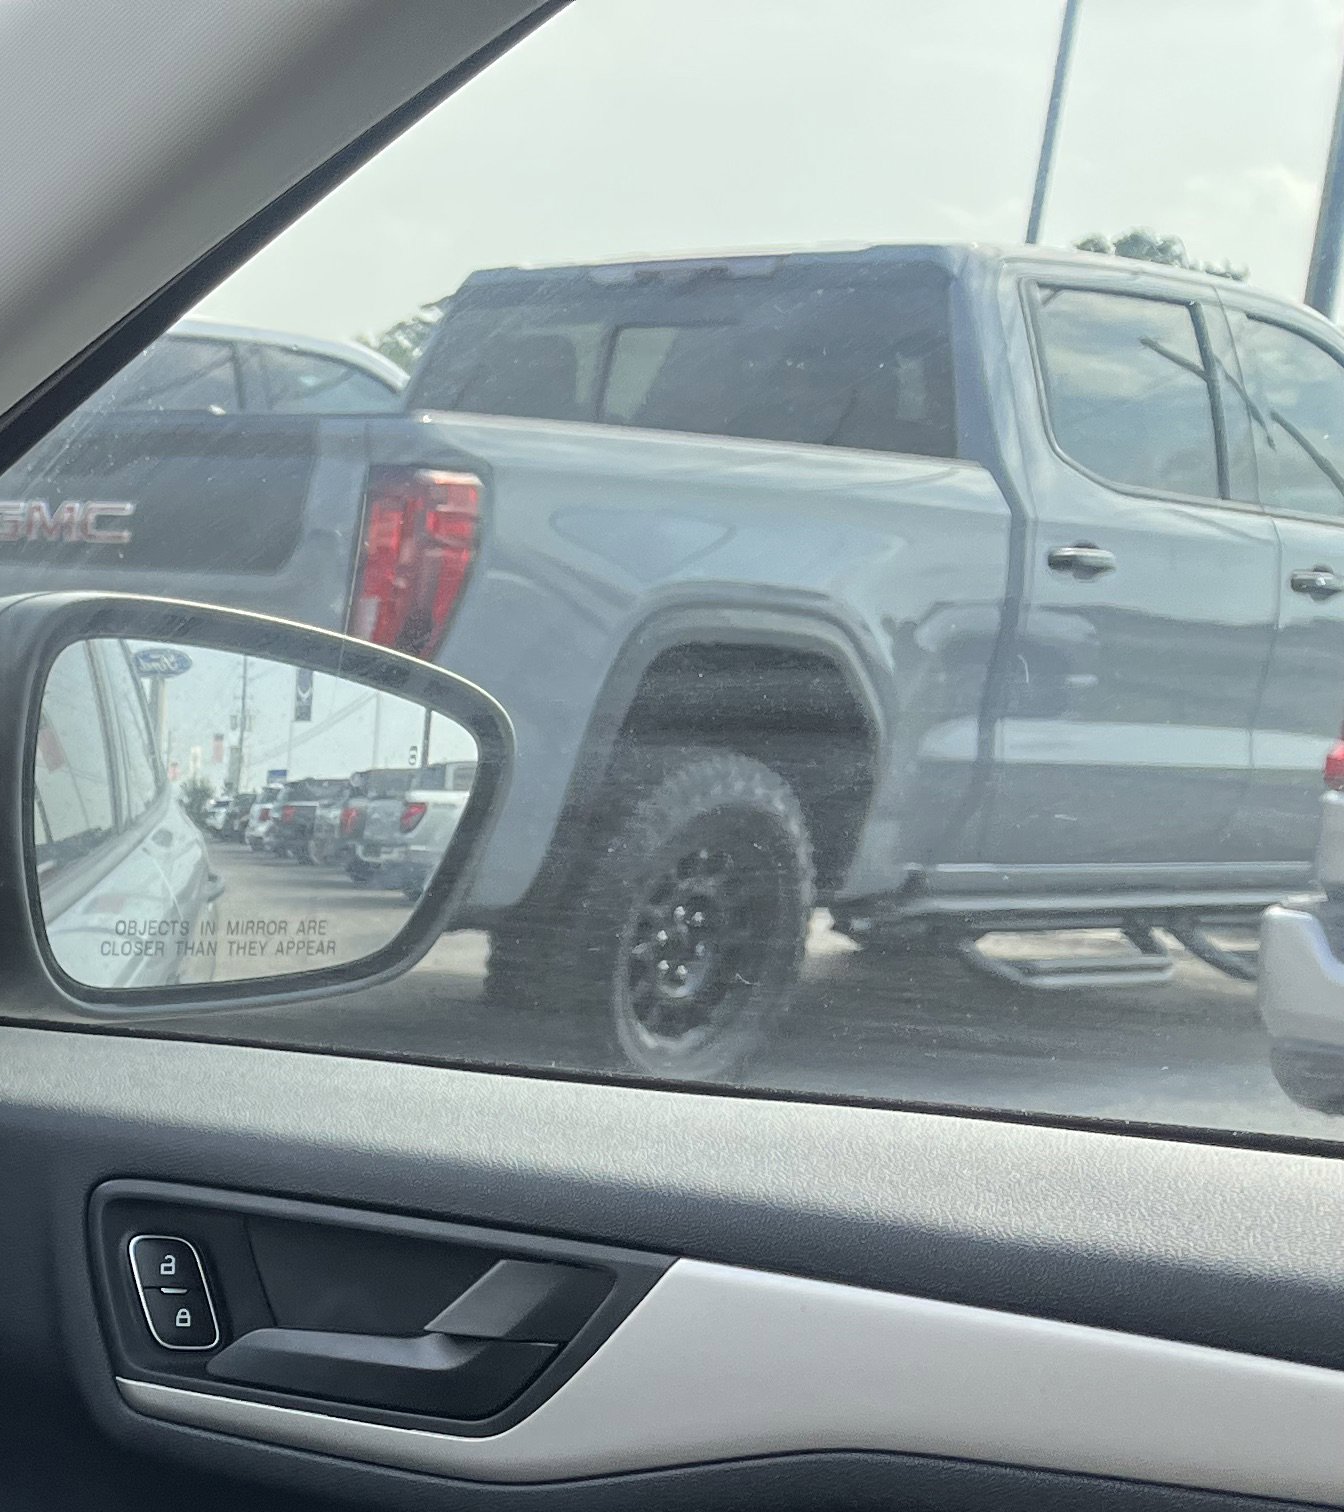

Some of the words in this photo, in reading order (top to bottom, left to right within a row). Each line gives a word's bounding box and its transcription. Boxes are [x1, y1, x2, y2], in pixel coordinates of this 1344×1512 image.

[115, 920, 190, 937] OBJECTS
[200, 920, 216, 936] IN
[226, 920, 288, 936] MIRROR
[296, 919, 328, 936] ARE
[100, 940, 165, 957] CLOSER
[176, 941, 217, 957] THAN
[228, 941, 269, 957] THEY
[275, 940, 337, 956] APPEAR
